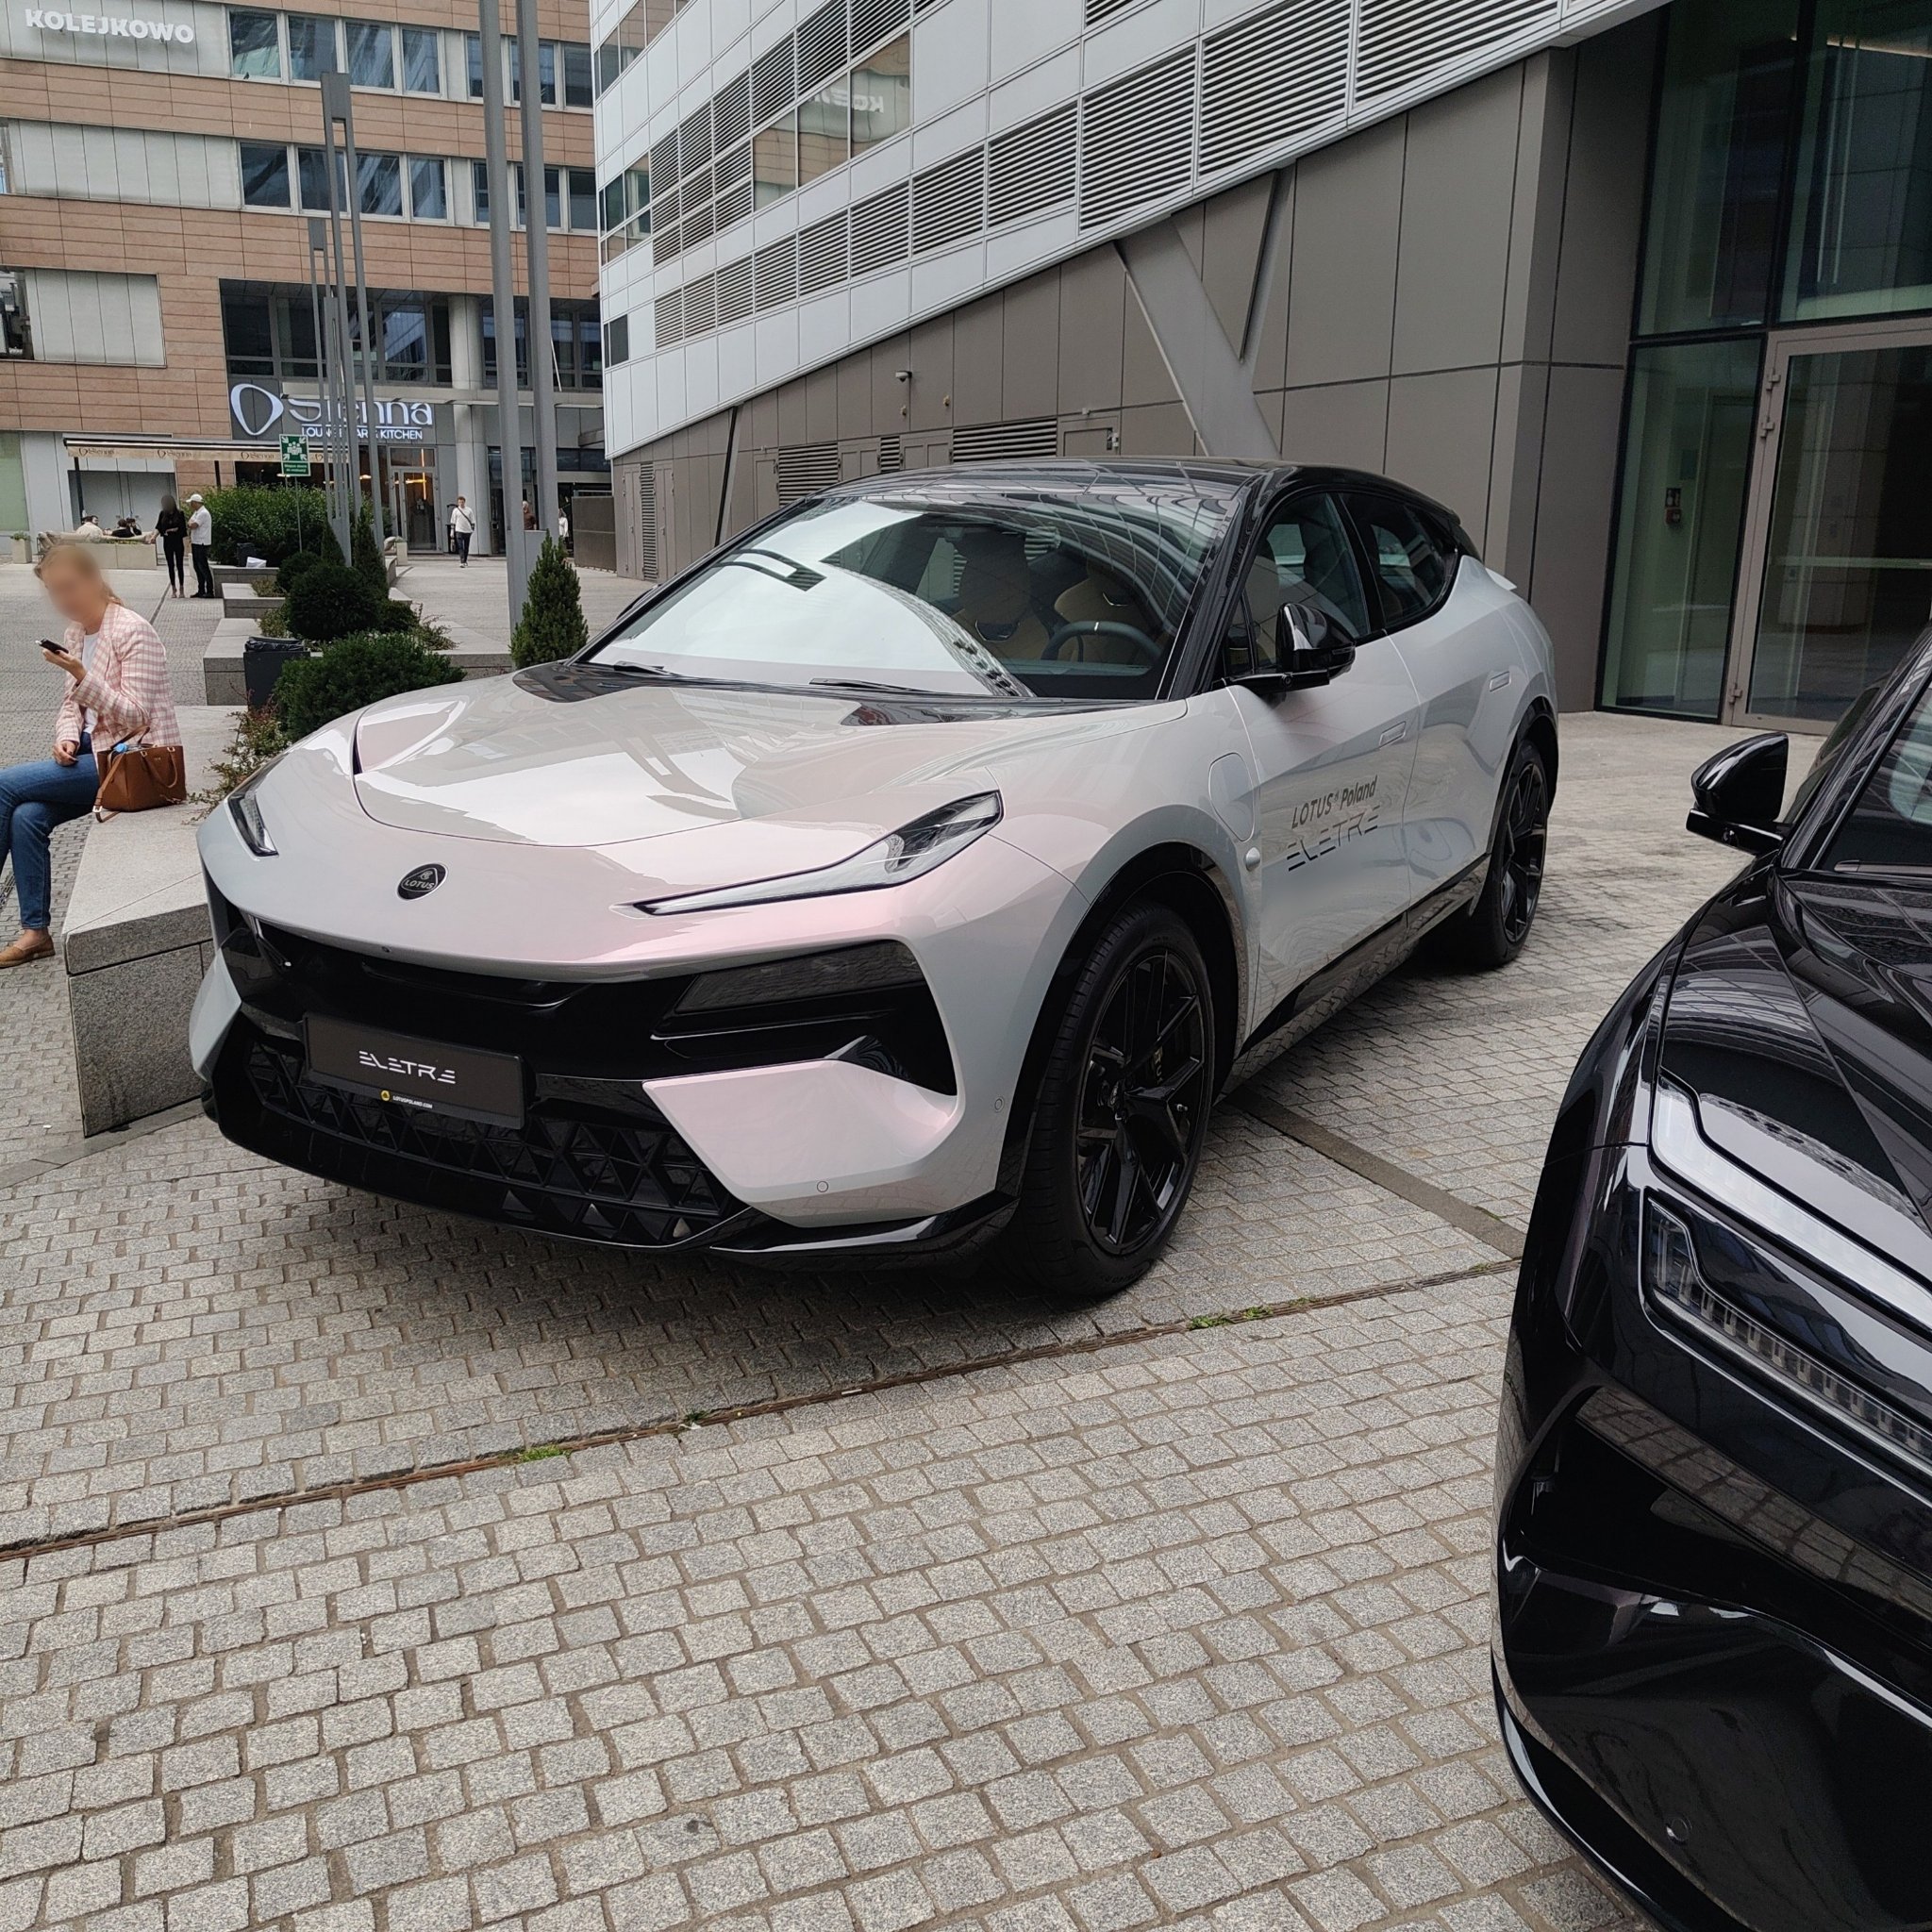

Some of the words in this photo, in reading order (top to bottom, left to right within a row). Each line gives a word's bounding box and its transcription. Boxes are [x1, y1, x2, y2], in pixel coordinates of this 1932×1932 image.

[25, 8, 194, 43] KOLEJKOWO
[380, 429, 423, 440] KITCHEN
[1291, 792, 1334, 830] LOTUS
[1340, 774, 1378, 810] Poland
[405, 879, 435, 890] LOTUS
